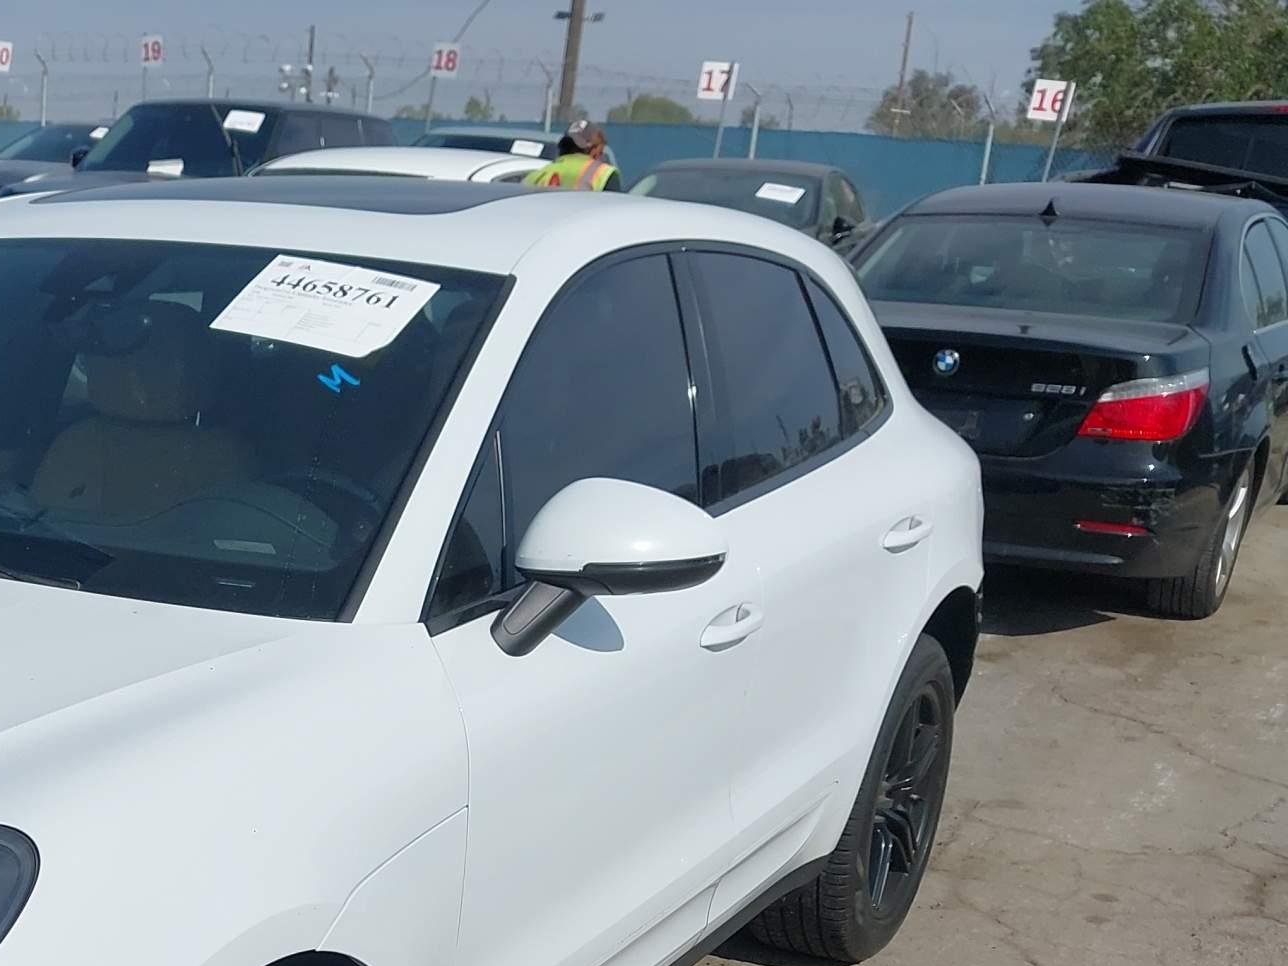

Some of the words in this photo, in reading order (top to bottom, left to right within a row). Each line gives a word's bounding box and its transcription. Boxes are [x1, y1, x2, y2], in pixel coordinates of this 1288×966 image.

[143, 41, 161, 61] 19
[433, 49, 457, 72] 18
[702, 70, 731, 92] 17
[1032, 89, 1064, 113] 16
[271, 273, 399, 310] 44658761
